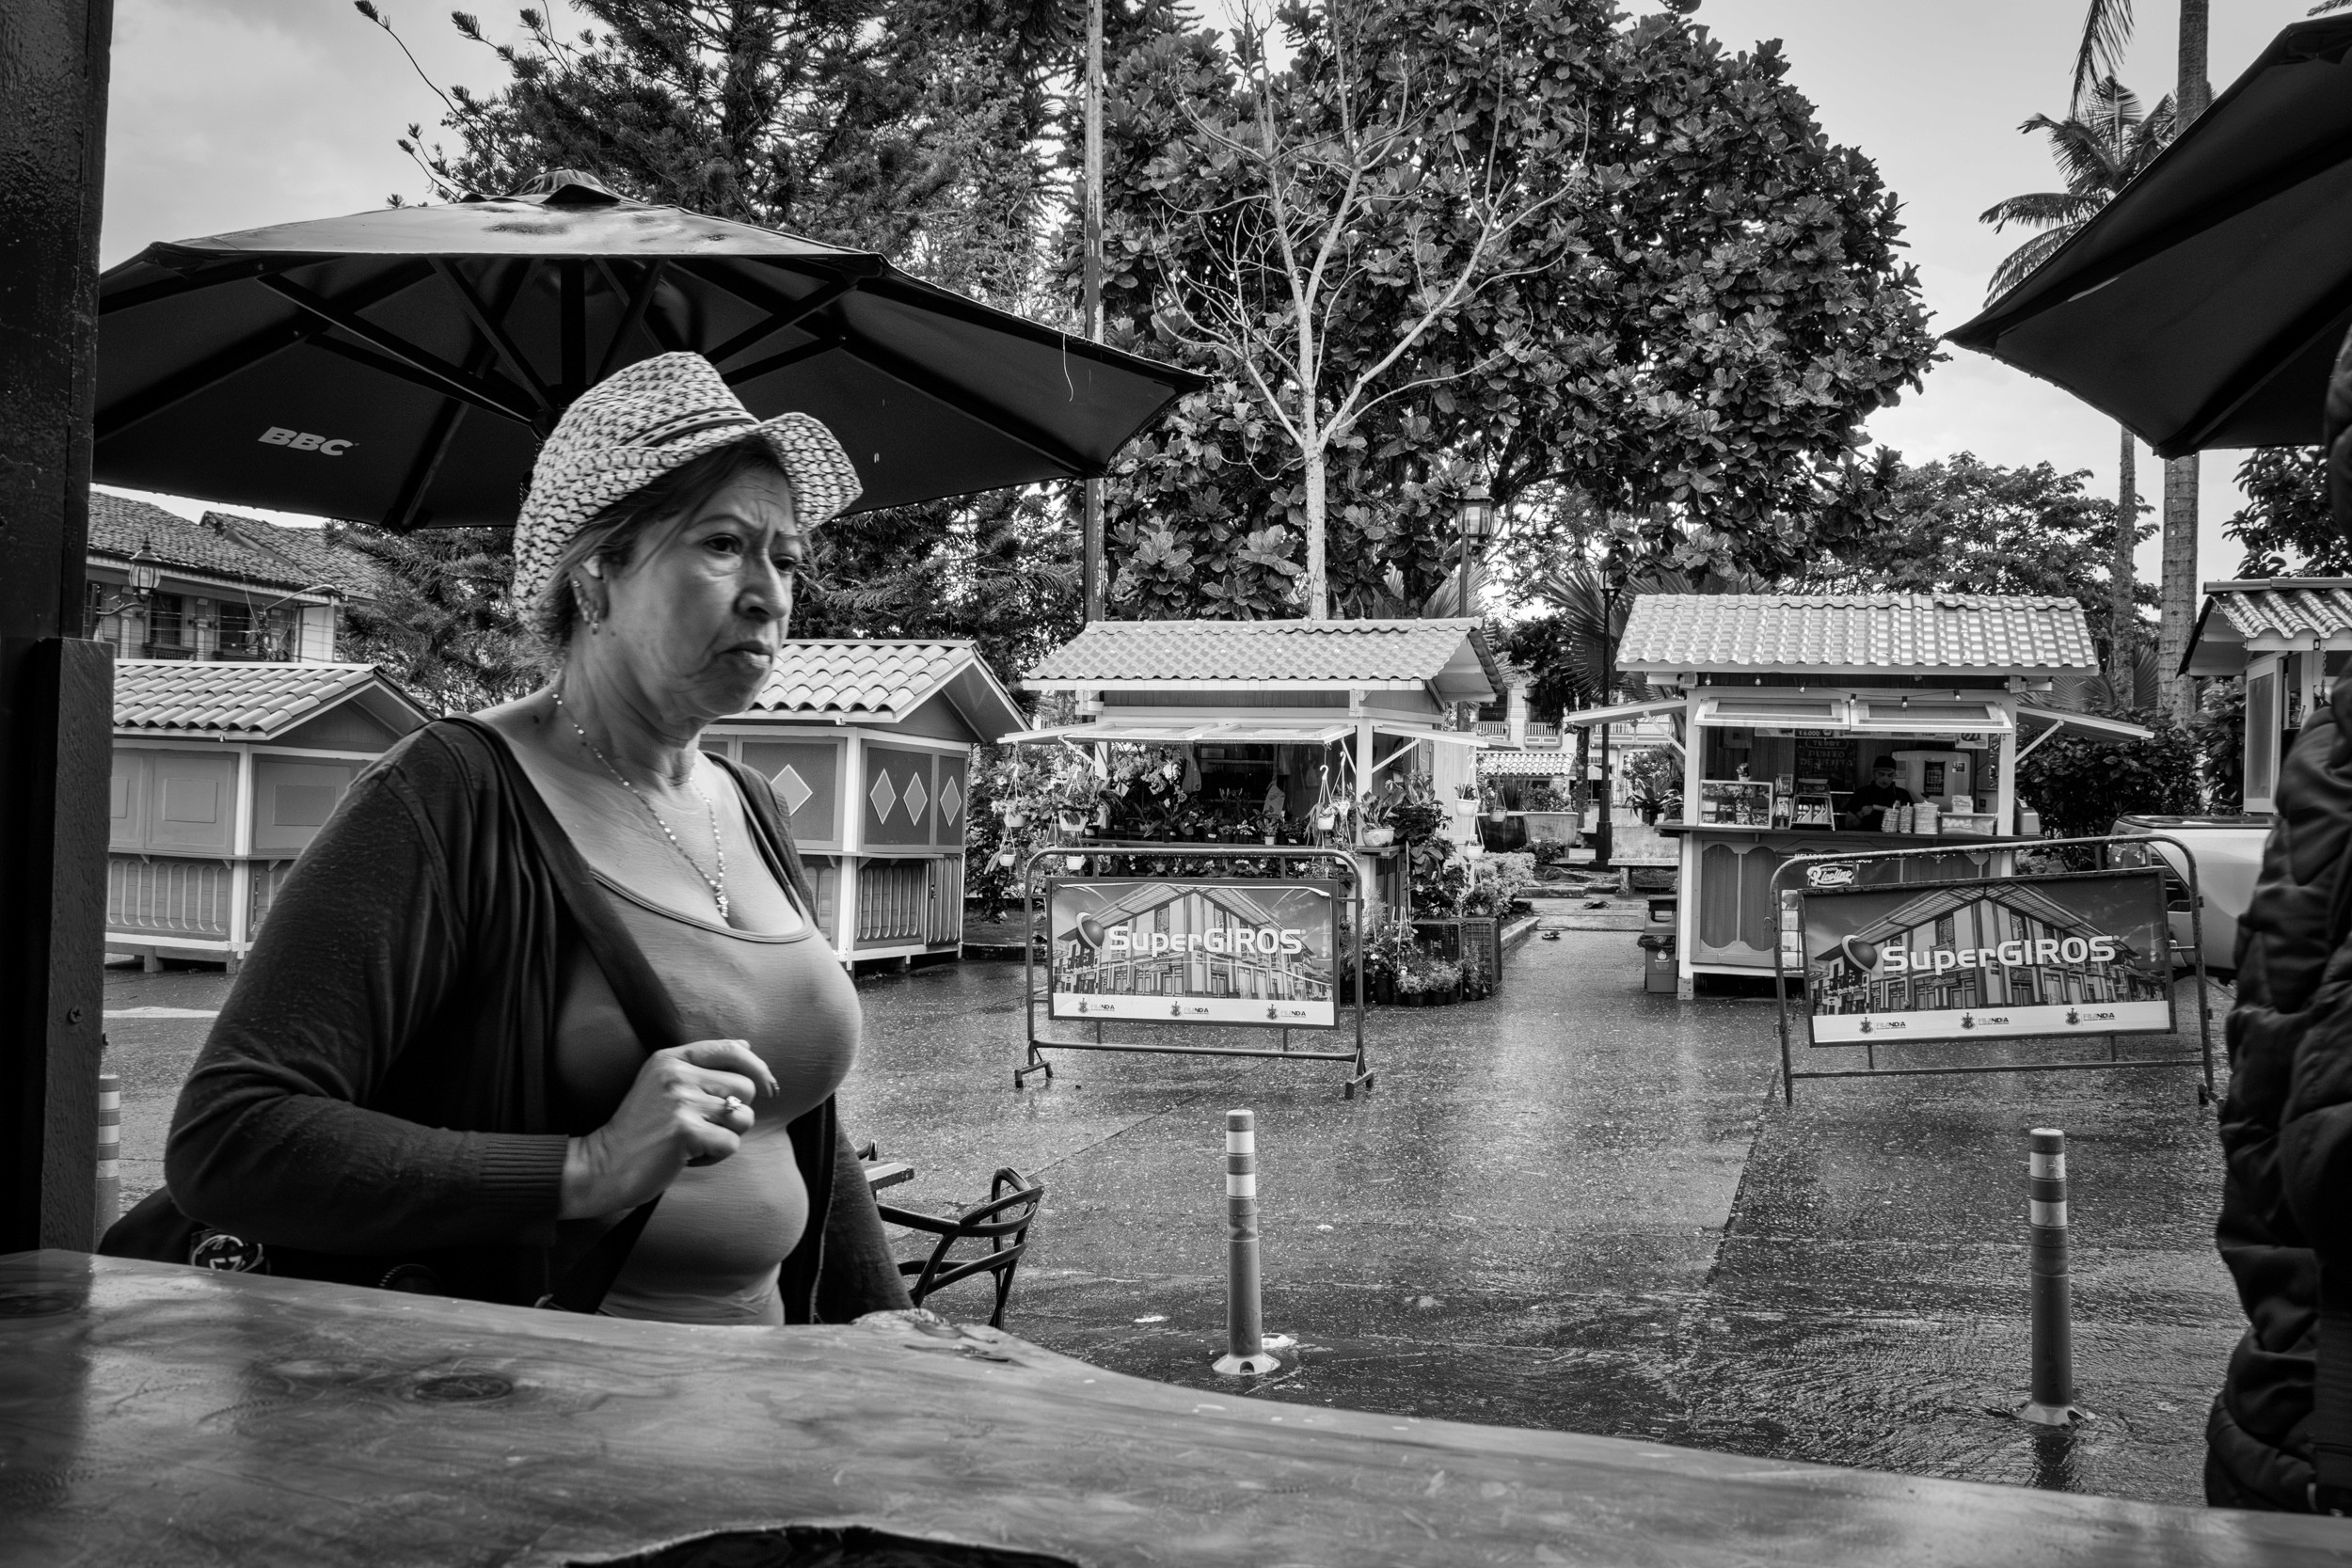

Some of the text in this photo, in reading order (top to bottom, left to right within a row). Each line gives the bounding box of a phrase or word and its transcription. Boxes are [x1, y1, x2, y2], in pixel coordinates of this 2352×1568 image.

[258, 426, 354, 456] BBC
[1108, 926, 1303, 958] SuperGIROS
[1882, 935, 2116, 975] SuperGIROS
